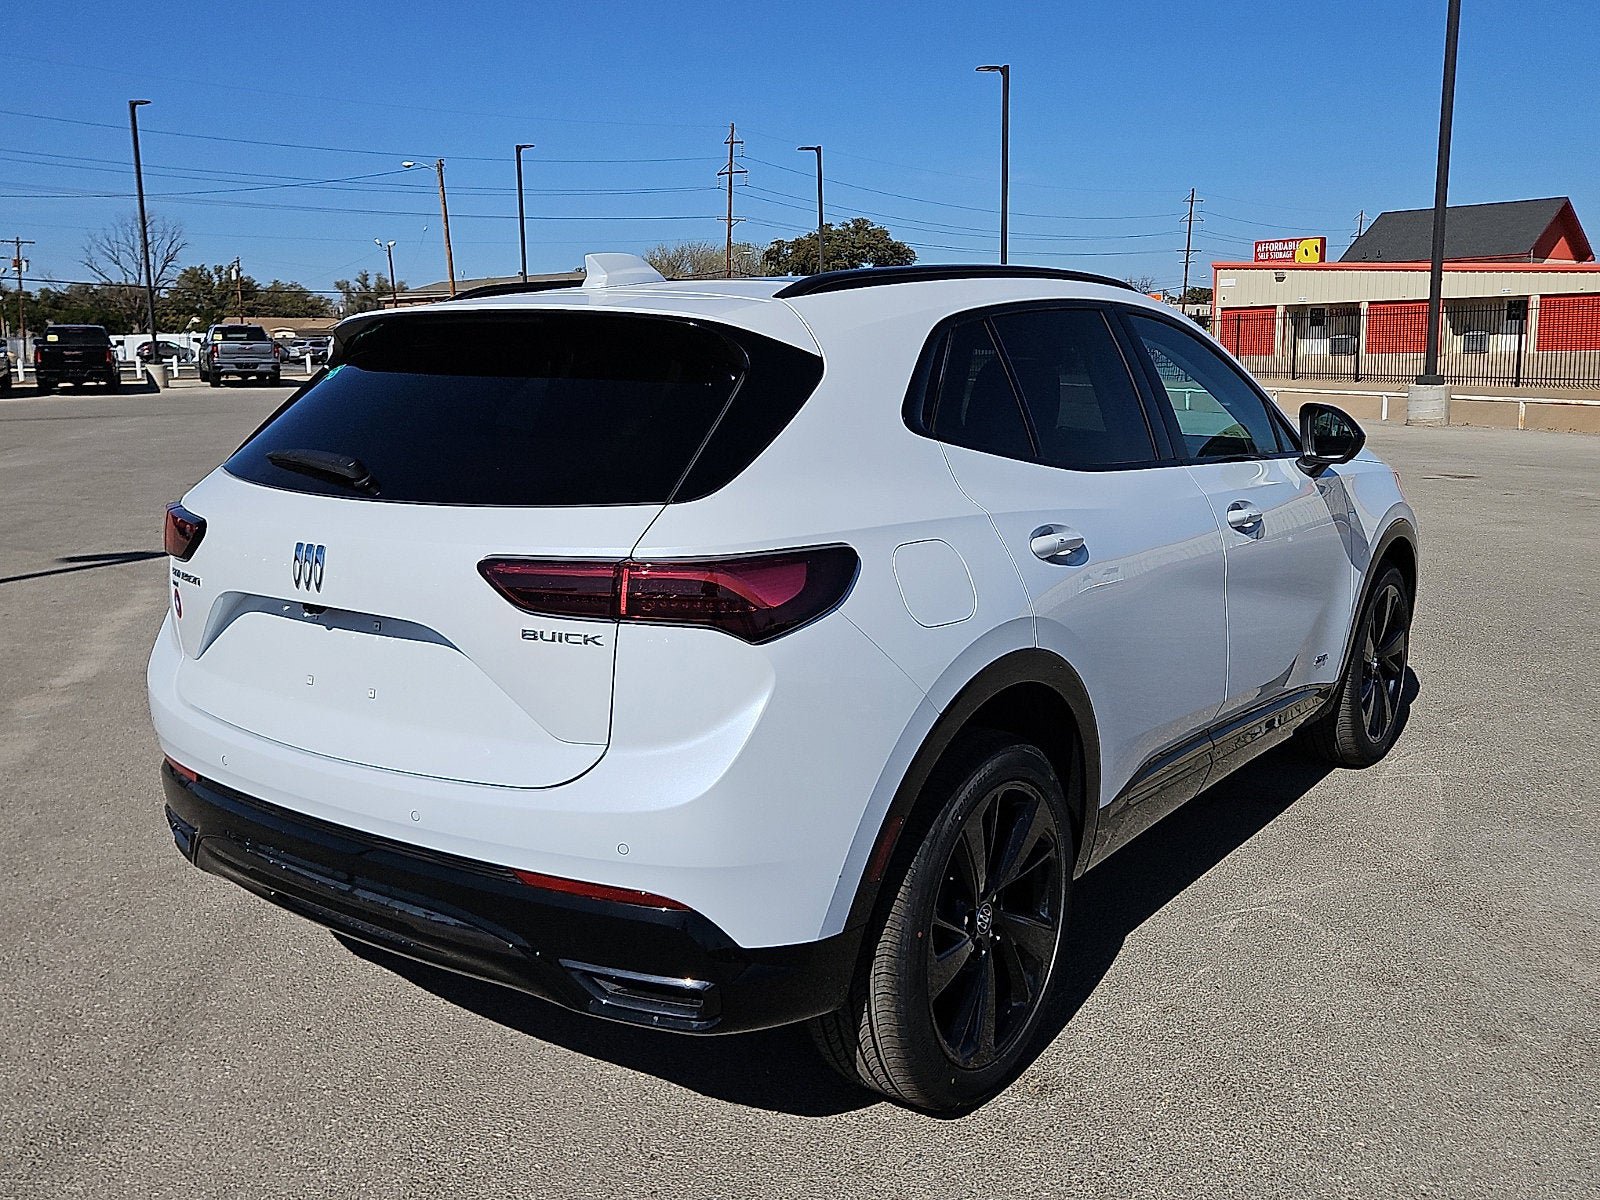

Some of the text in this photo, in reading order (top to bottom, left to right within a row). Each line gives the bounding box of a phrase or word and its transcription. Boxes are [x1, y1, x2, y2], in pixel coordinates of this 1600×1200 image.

[1257, 241, 1300, 252] AFFORDABLE
[1258, 251, 1293, 260] SELF STORAGE
[521, 629, 604, 647] BUICK
